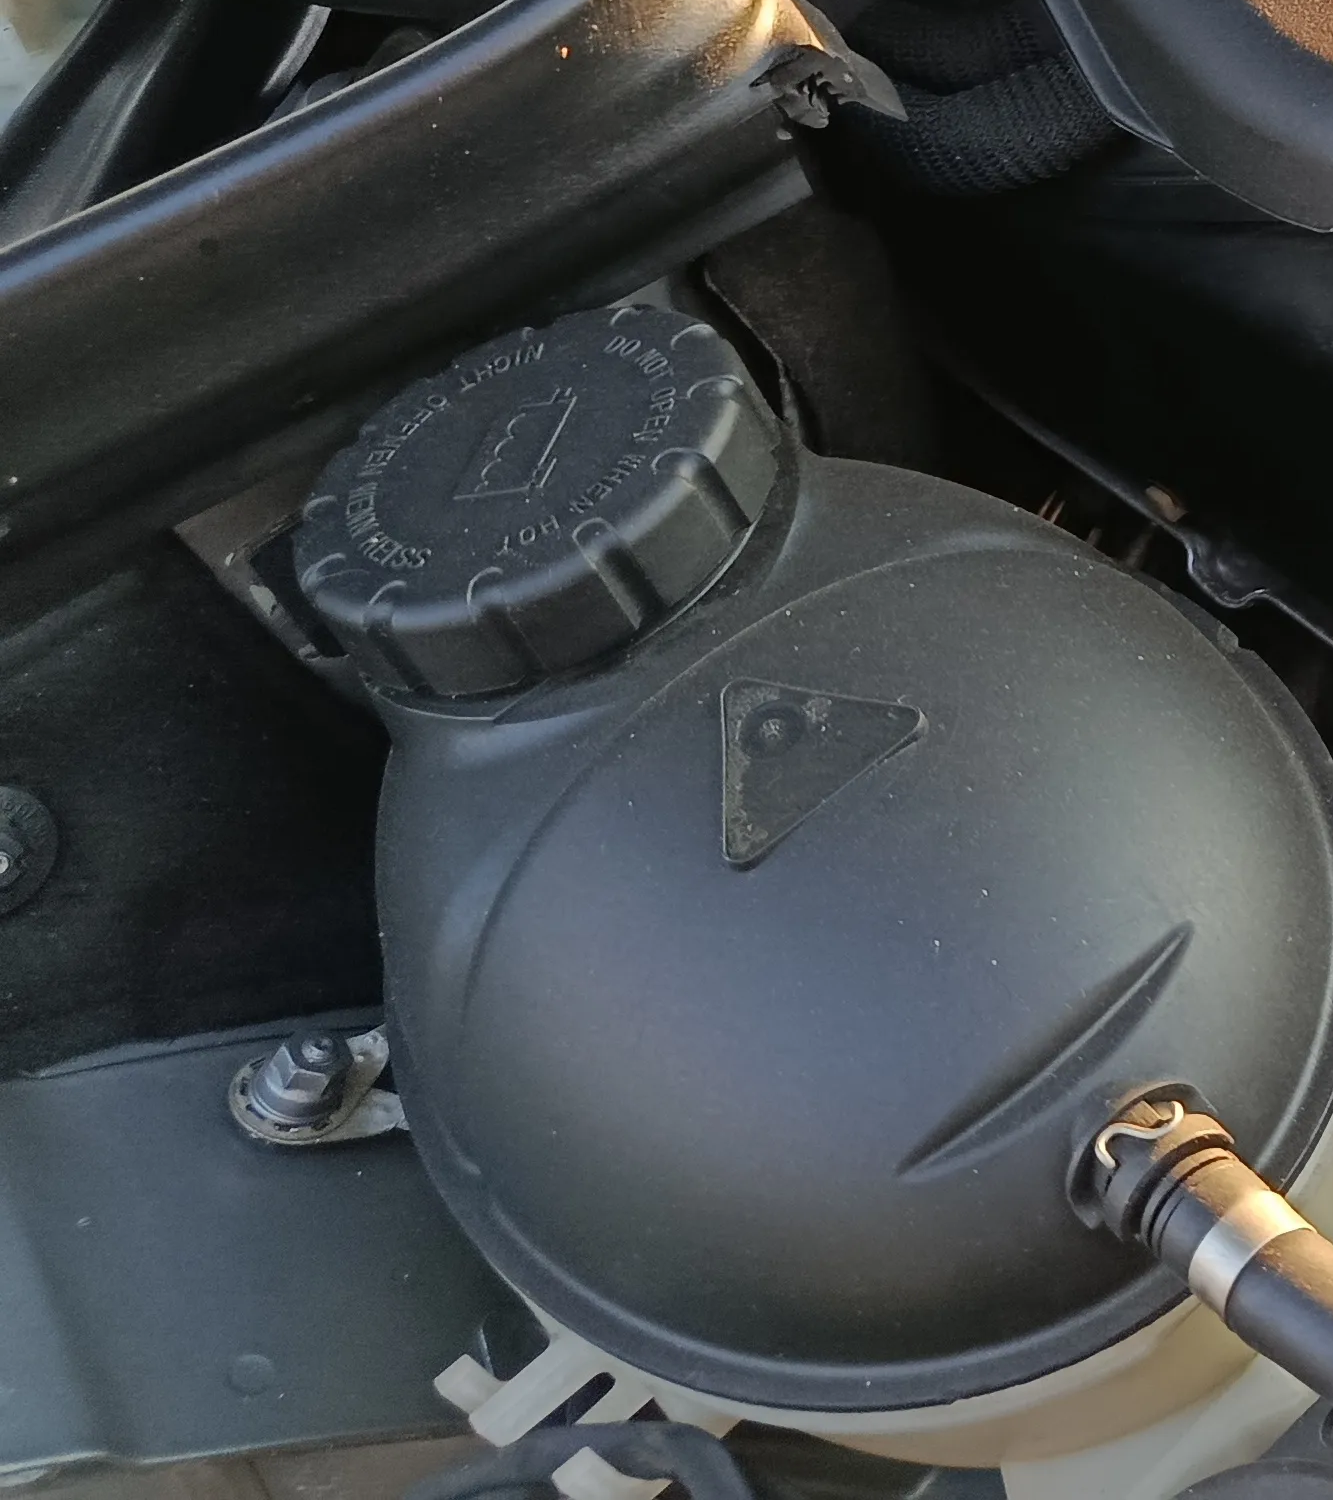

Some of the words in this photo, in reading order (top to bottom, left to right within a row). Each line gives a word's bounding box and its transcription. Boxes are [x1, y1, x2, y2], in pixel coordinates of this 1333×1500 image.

[459, 343, 545, 392] NICHT
[603, 335, 642, 357] DO
[633, 348, 675, 381] NOT
[632, 386, 677, 443] OPEN
[568, 453, 647, 515] WHEN
[345, 482, 380, 540] WENN
[360, 530, 432, 569] HEISS
[497, 514, 561, 556] HOT
